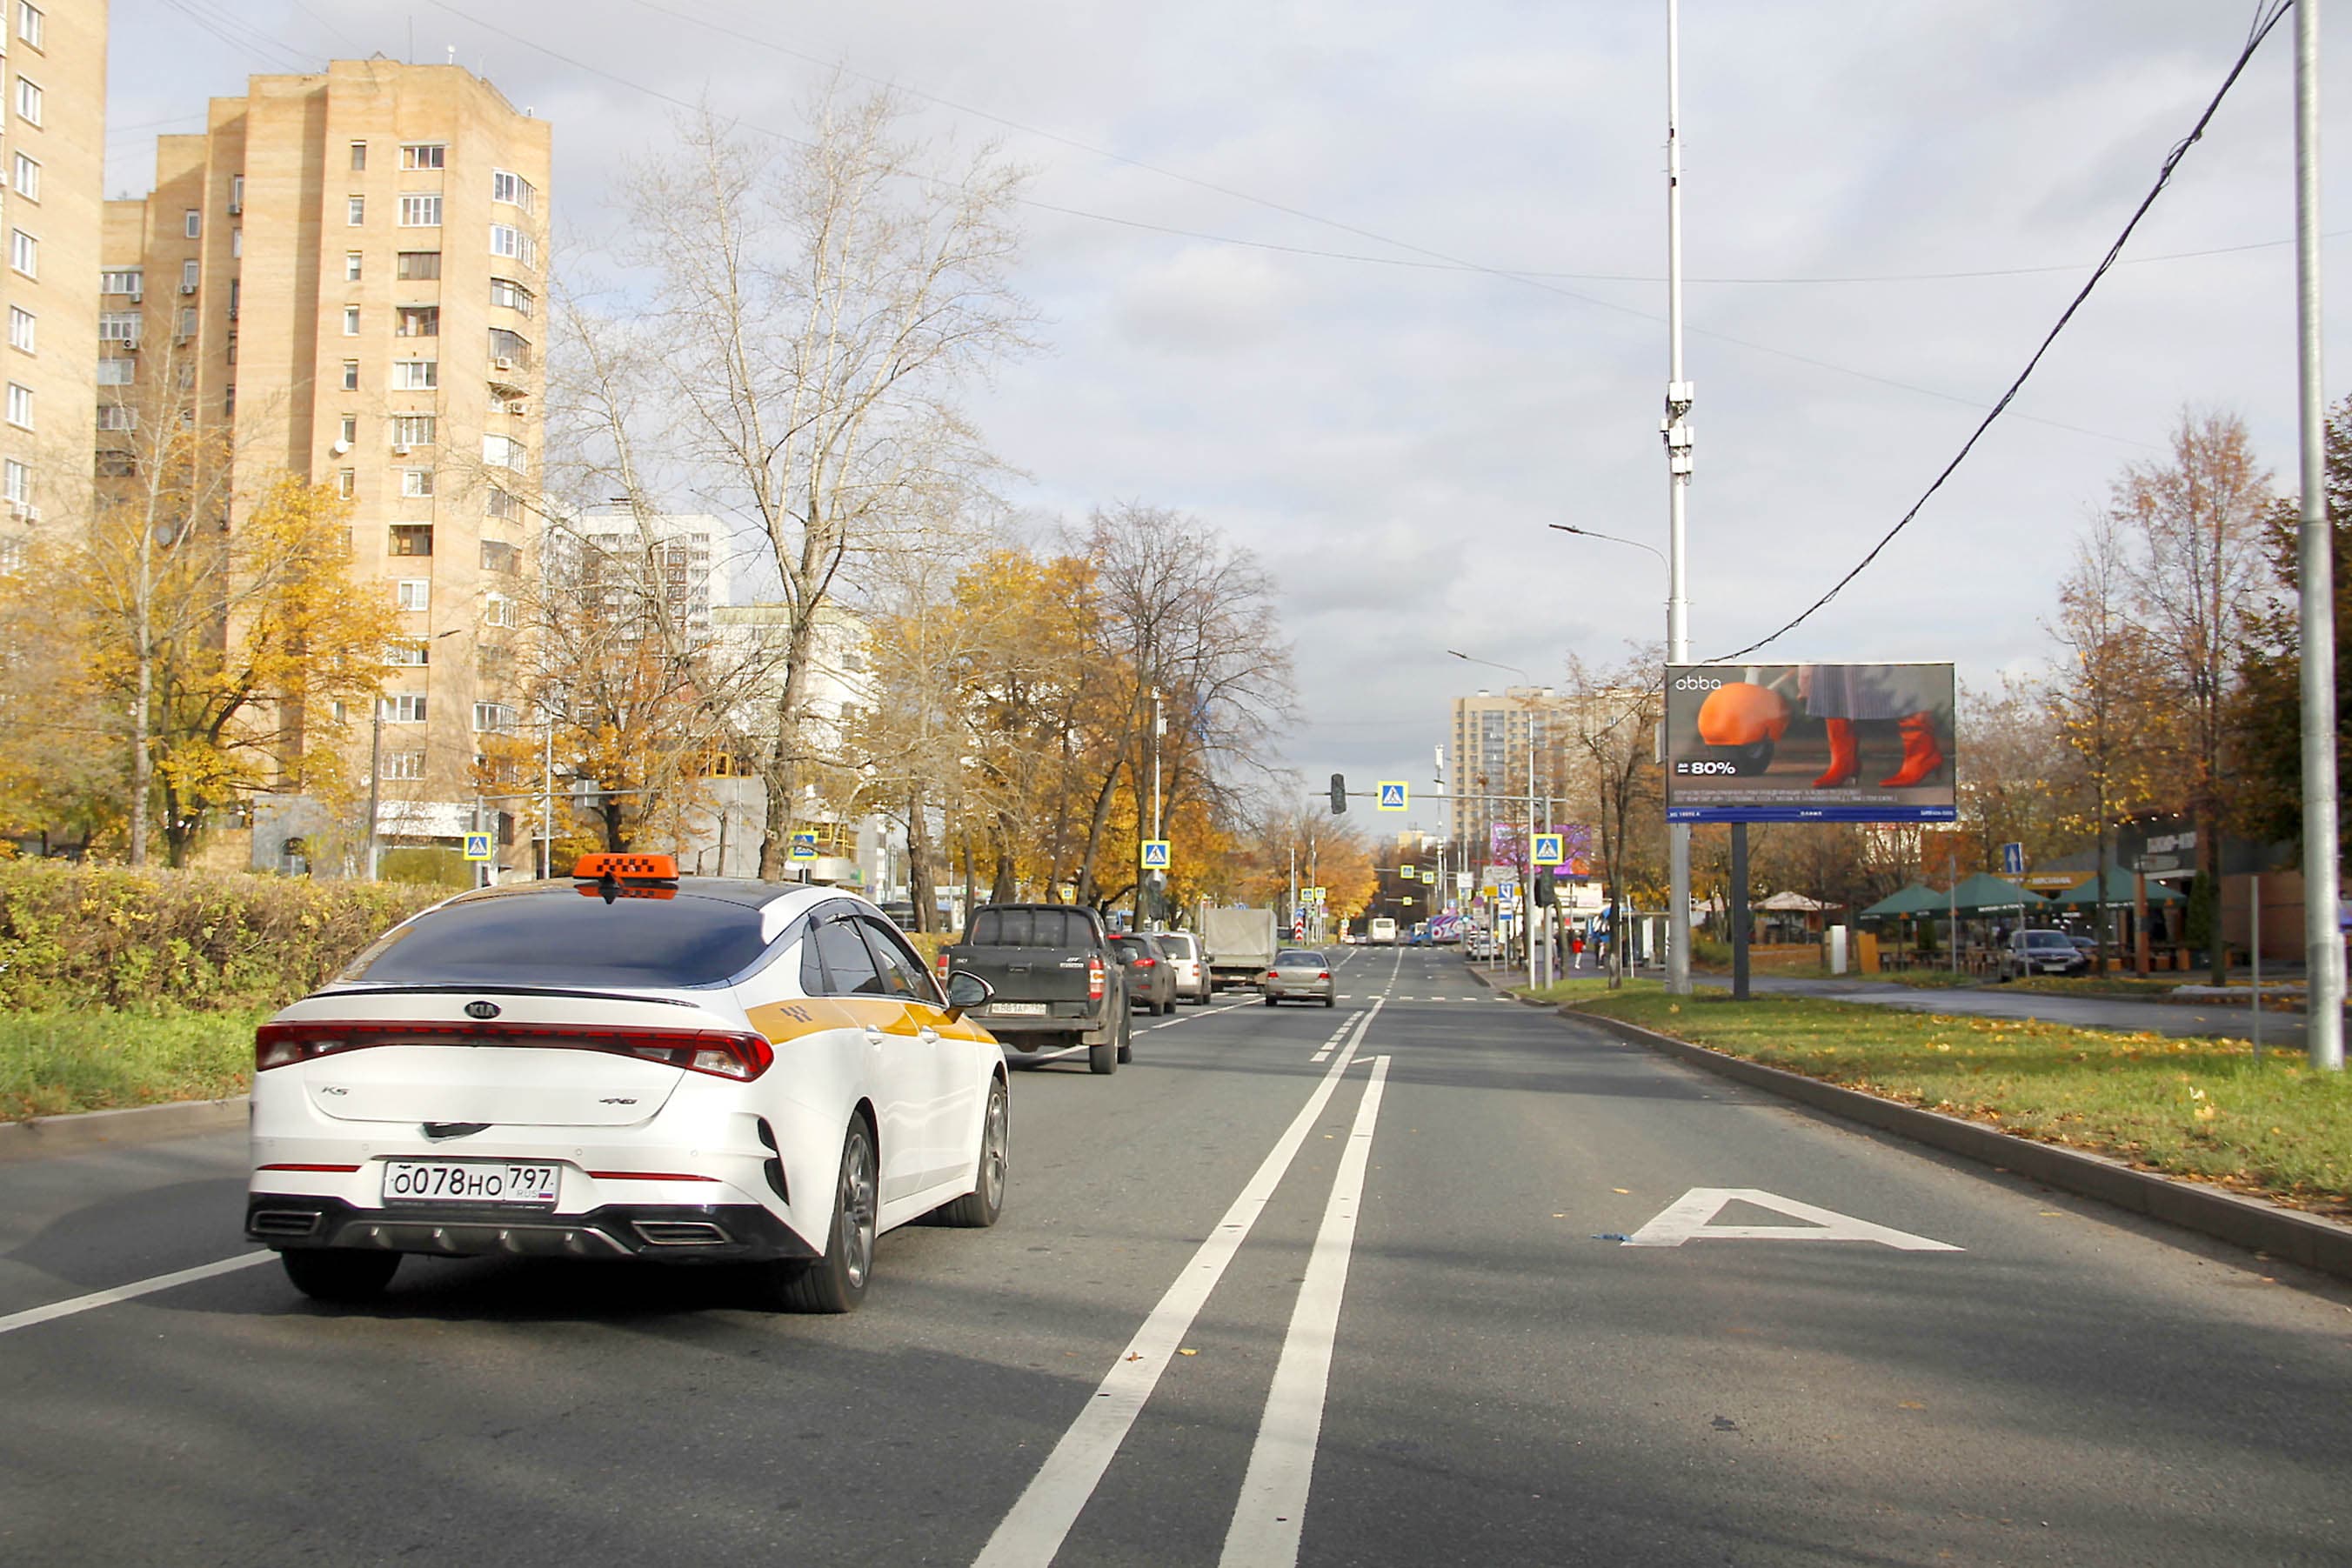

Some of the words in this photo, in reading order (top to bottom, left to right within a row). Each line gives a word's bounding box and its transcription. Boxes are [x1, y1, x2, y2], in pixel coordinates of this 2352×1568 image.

[1691, 761, 1736, 775] 80%
[469, 1004, 496, 1017] KIA
[510, 1167, 551, 1190] 797
[517, 1190, 538, 1198] RUS
